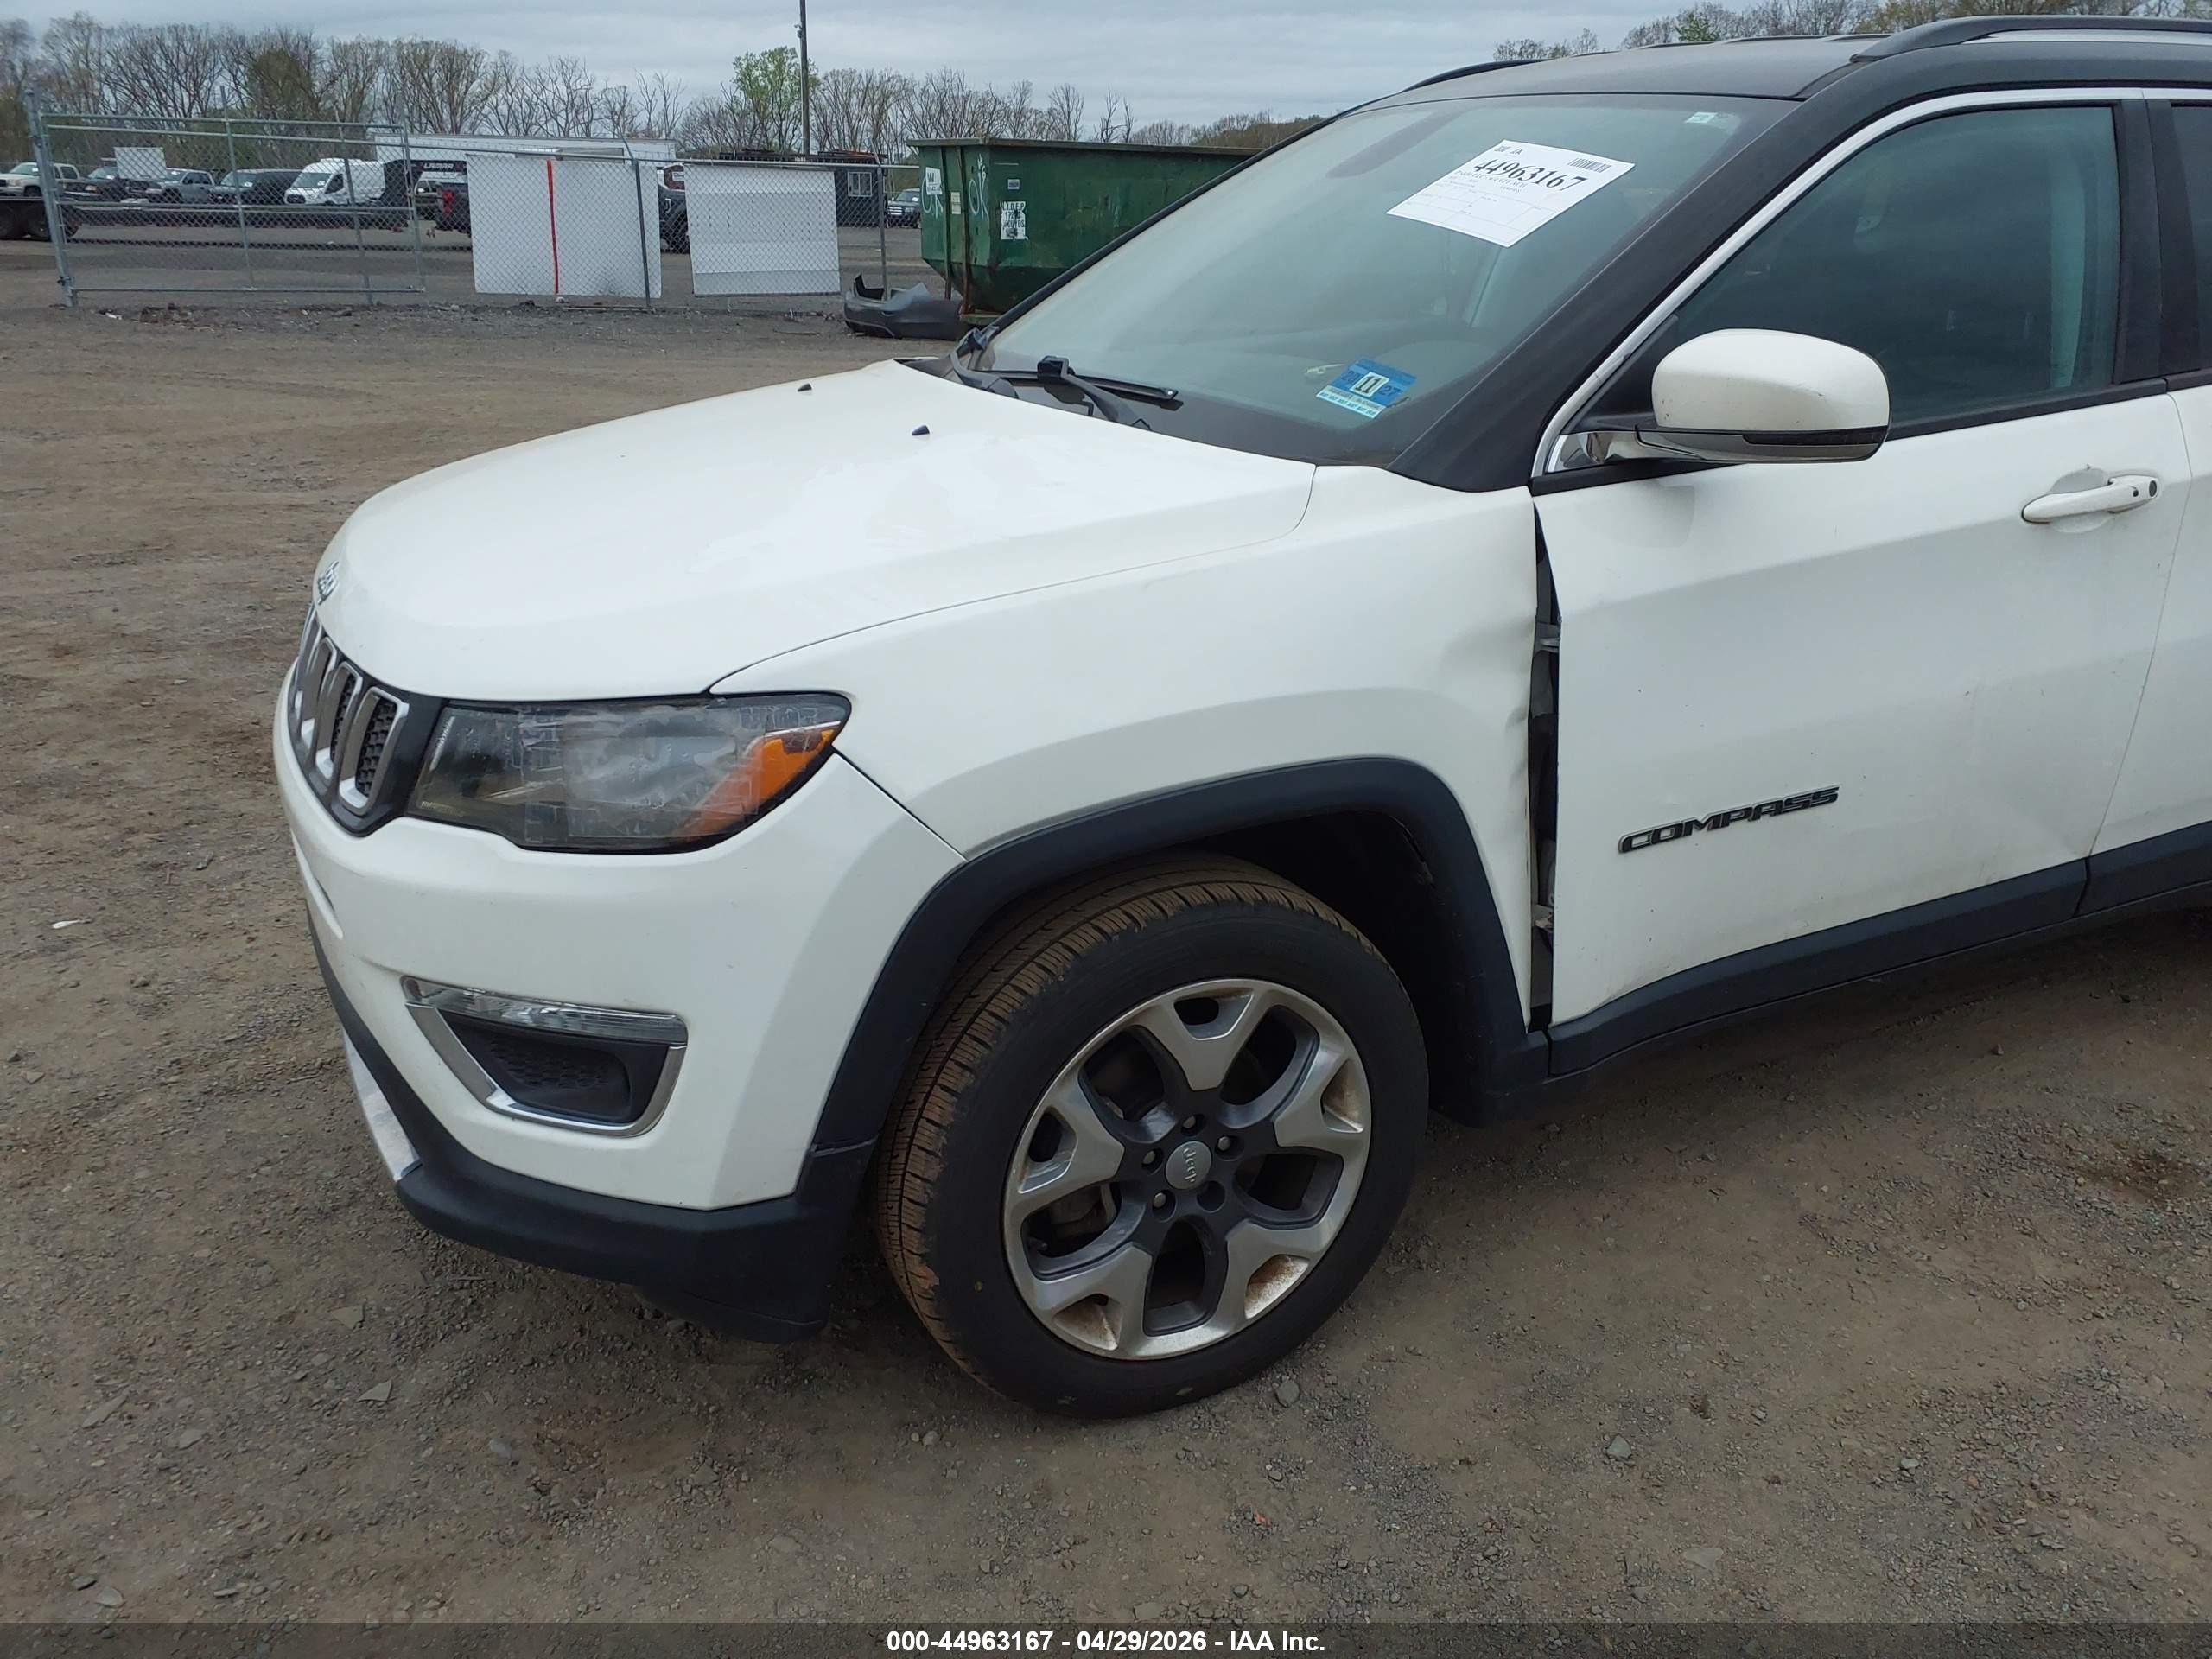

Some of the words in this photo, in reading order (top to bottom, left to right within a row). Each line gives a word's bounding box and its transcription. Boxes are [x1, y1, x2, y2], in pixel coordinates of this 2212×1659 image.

[1473, 158, 1589, 191] 44963167
[1354, 375, 1382, 394] 11
[1618, 783, 1840, 854] COMPASS
[1182, 1147, 1198, 1183] Jeep
